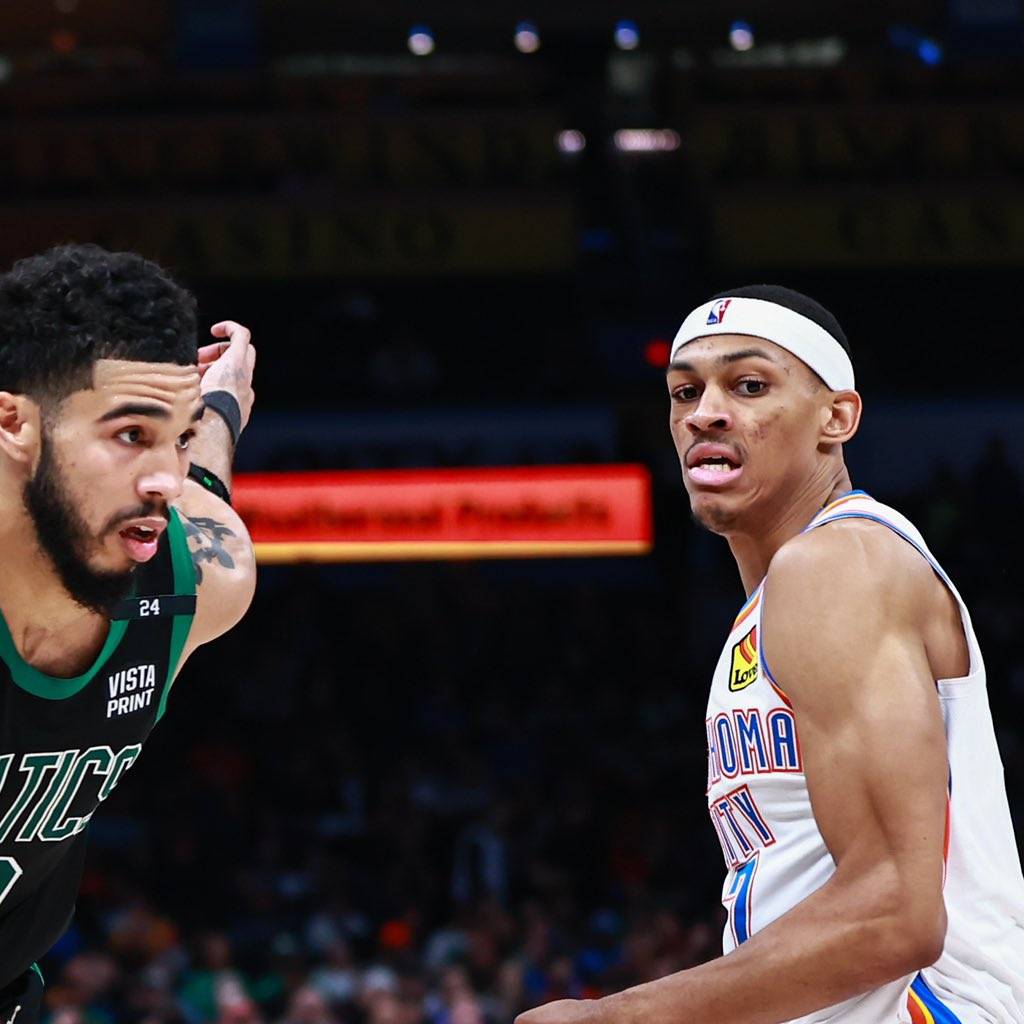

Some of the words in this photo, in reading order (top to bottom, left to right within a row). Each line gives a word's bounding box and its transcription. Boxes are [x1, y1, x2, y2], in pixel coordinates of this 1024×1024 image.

[139, 598, 161, 617] 24
[108, 664, 156, 699] VISTA
[106, 688, 155, 718] PRINT
[706, 707, 803, 786] HOMA
